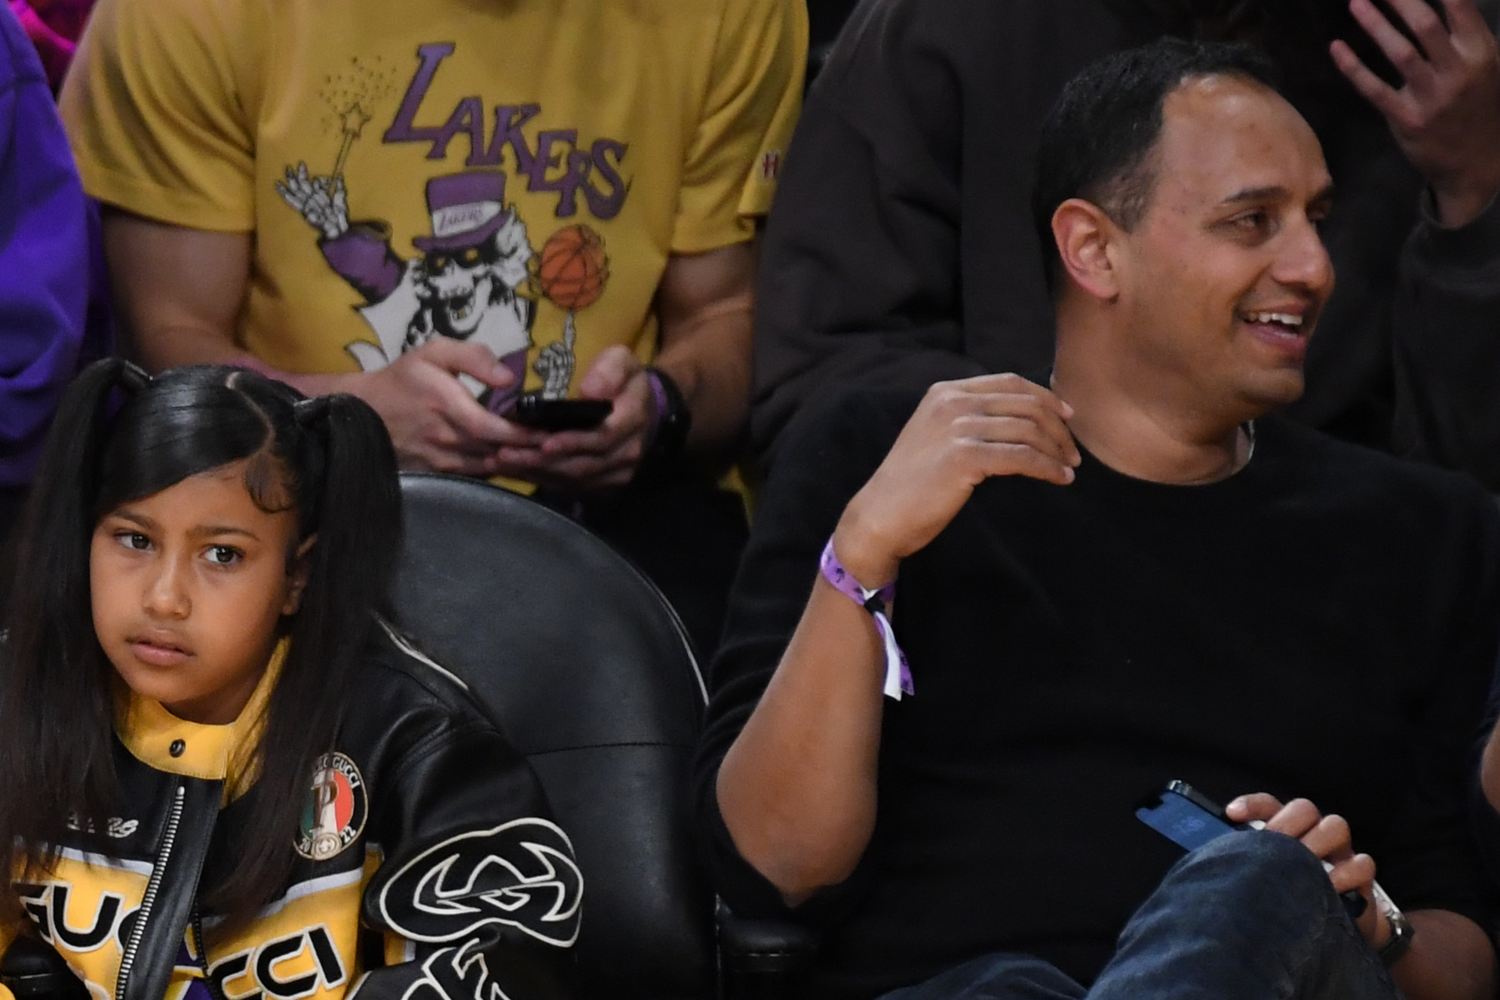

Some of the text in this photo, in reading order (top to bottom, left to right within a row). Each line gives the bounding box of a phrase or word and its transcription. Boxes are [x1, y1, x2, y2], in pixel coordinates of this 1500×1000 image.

[382, 42, 634, 221] LAKERS
[332, 757, 361, 789] GUCCI
[341, 826, 357, 843] 22
